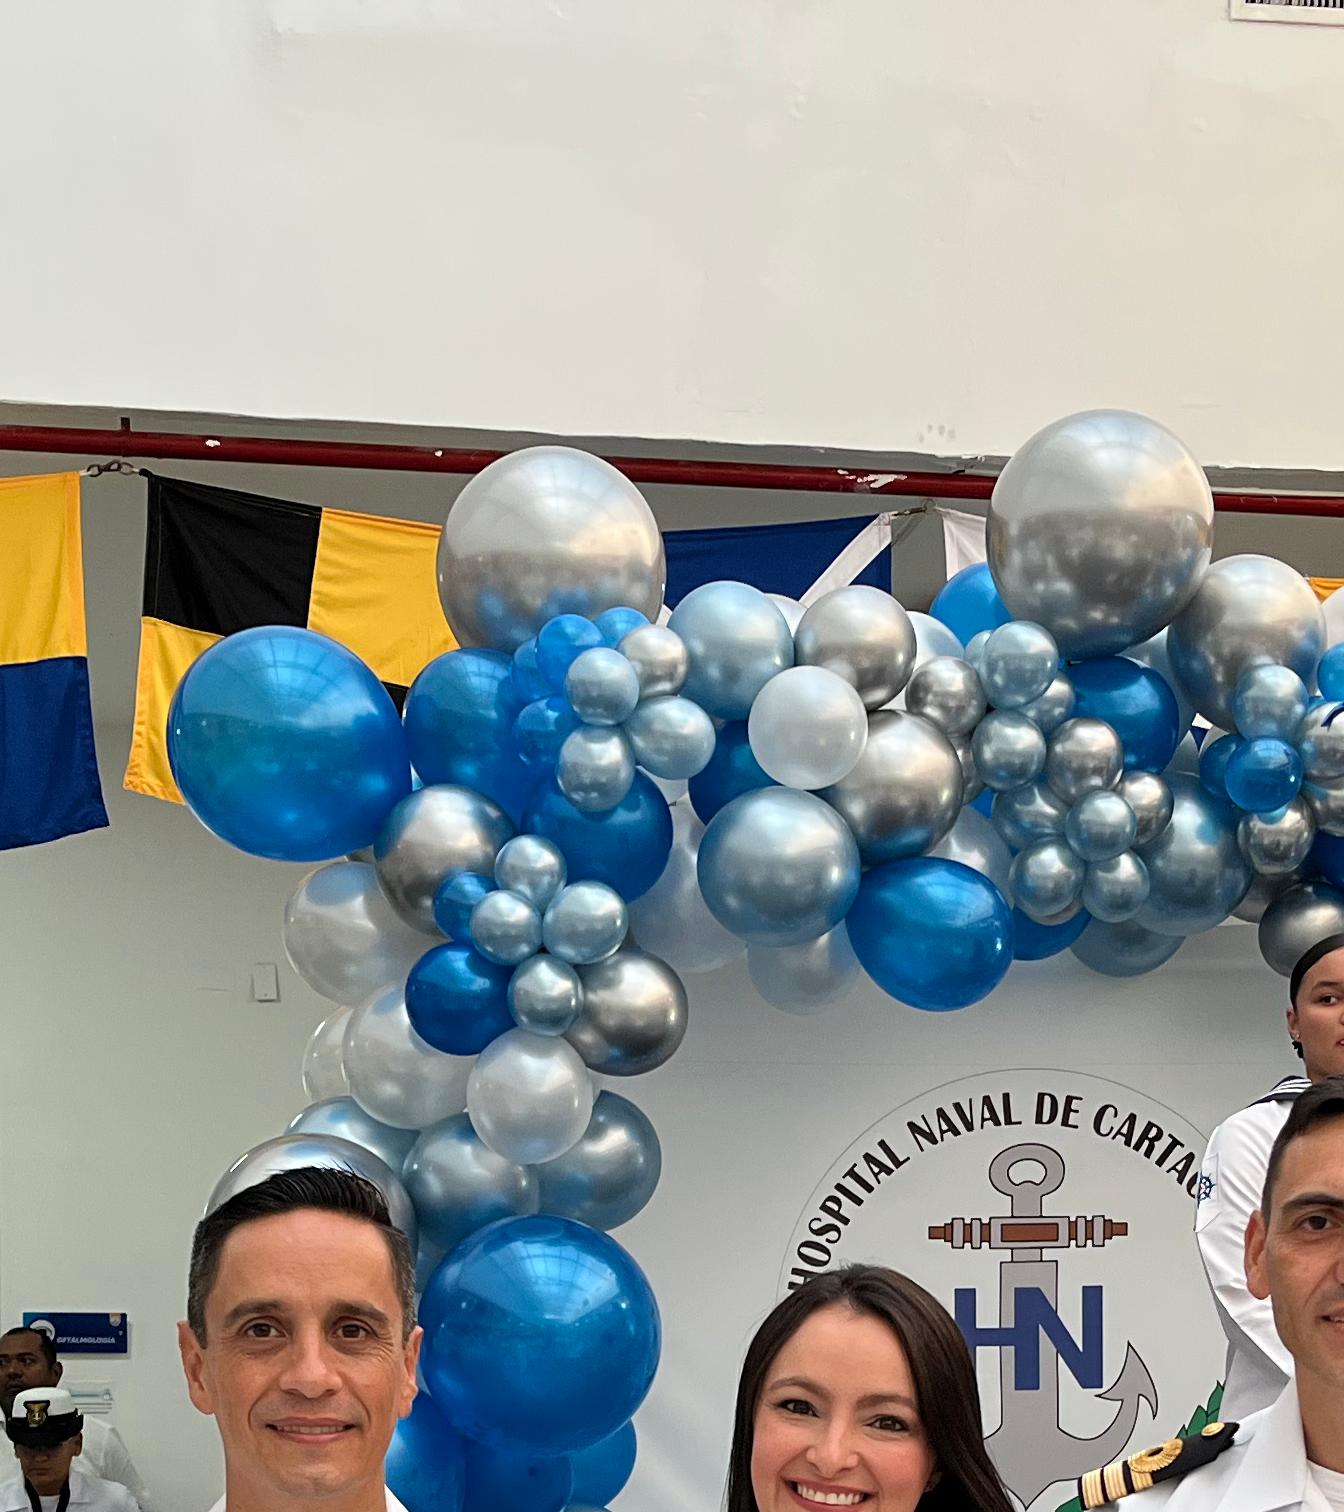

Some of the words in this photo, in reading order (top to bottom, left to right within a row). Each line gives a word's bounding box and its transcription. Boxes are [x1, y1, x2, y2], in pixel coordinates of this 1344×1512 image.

[787, 1138, 911, 1292] HOSPITAL
[906, 1091, 1023, 1152] NAVAL
[1034, 1091, 1084, 1130] DE
[953, 1284, 1104, 1391] HN
